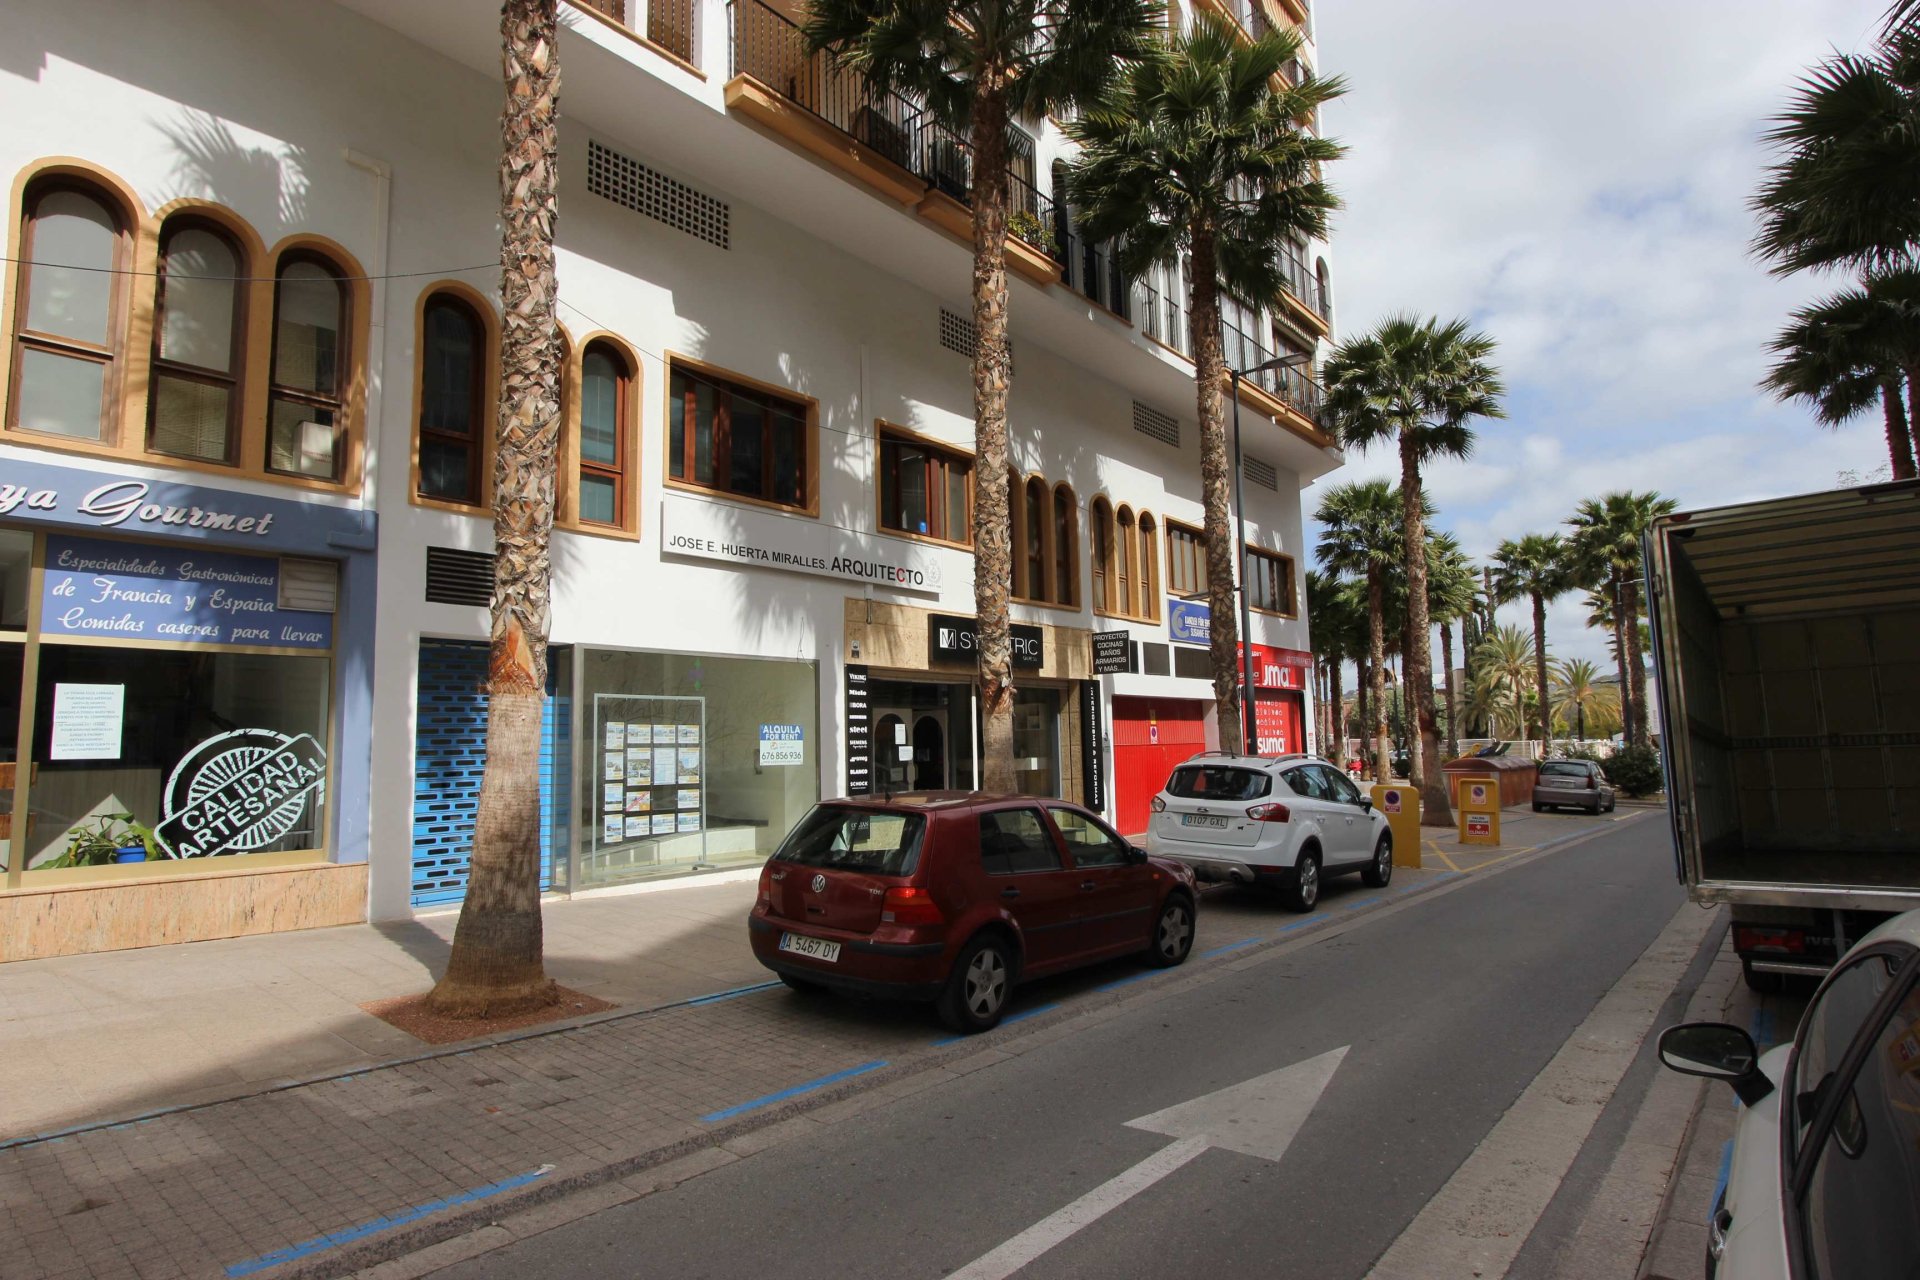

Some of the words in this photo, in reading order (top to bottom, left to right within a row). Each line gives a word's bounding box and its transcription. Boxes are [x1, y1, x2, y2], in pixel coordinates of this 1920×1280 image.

[77, 481, 273, 535] Gourmet
[58, 549, 166, 575] Especialidades
[177, 561, 275, 586] Gastronómicas
[669, 535, 703, 550] JOSE
[707, 541, 718, 553] E.
[721, 543, 769, 561] HUERTA
[772, 551, 828, 570] MIRALLES.
[831, 556, 924, 585] ARQUITECTO
[52, 577, 76, 597] de
[90, 577, 172, 604] Francia
[185, 595, 196, 611] y
[210, 588, 275, 613] España
[57, 606, 144, 632] Comidas
[157, 621, 219, 637] caseras
[231, 628, 270, 643] para
[280, 626, 323, 643] llevar
[1093, 632, 1128, 641] PROYECTOS
[960, 631, 1038, 656] SYTRIC
[1097, 641, 1124, 649] COCINAS
[1095, 656, 1127, 664] ARMARIOS
[762, 725, 801, 734] ALQUILA
[765, 733, 780, 741] FOR
[761, 752, 775, 760] 676
[775, 751, 789, 760] 856
[789, 751, 802, 760] 936
[1257, 737, 1285, 754] suma
[181, 752, 298, 831] CALIDAD
[178, 757, 326, 860] ARTESANAL
[1187, 815, 1208, 825] 0107
[1209, 817, 1225, 827] GXL
[785, 935, 792, 949] A
[795, 937, 821, 955] 5467
[822, 943, 838, 959] DY
